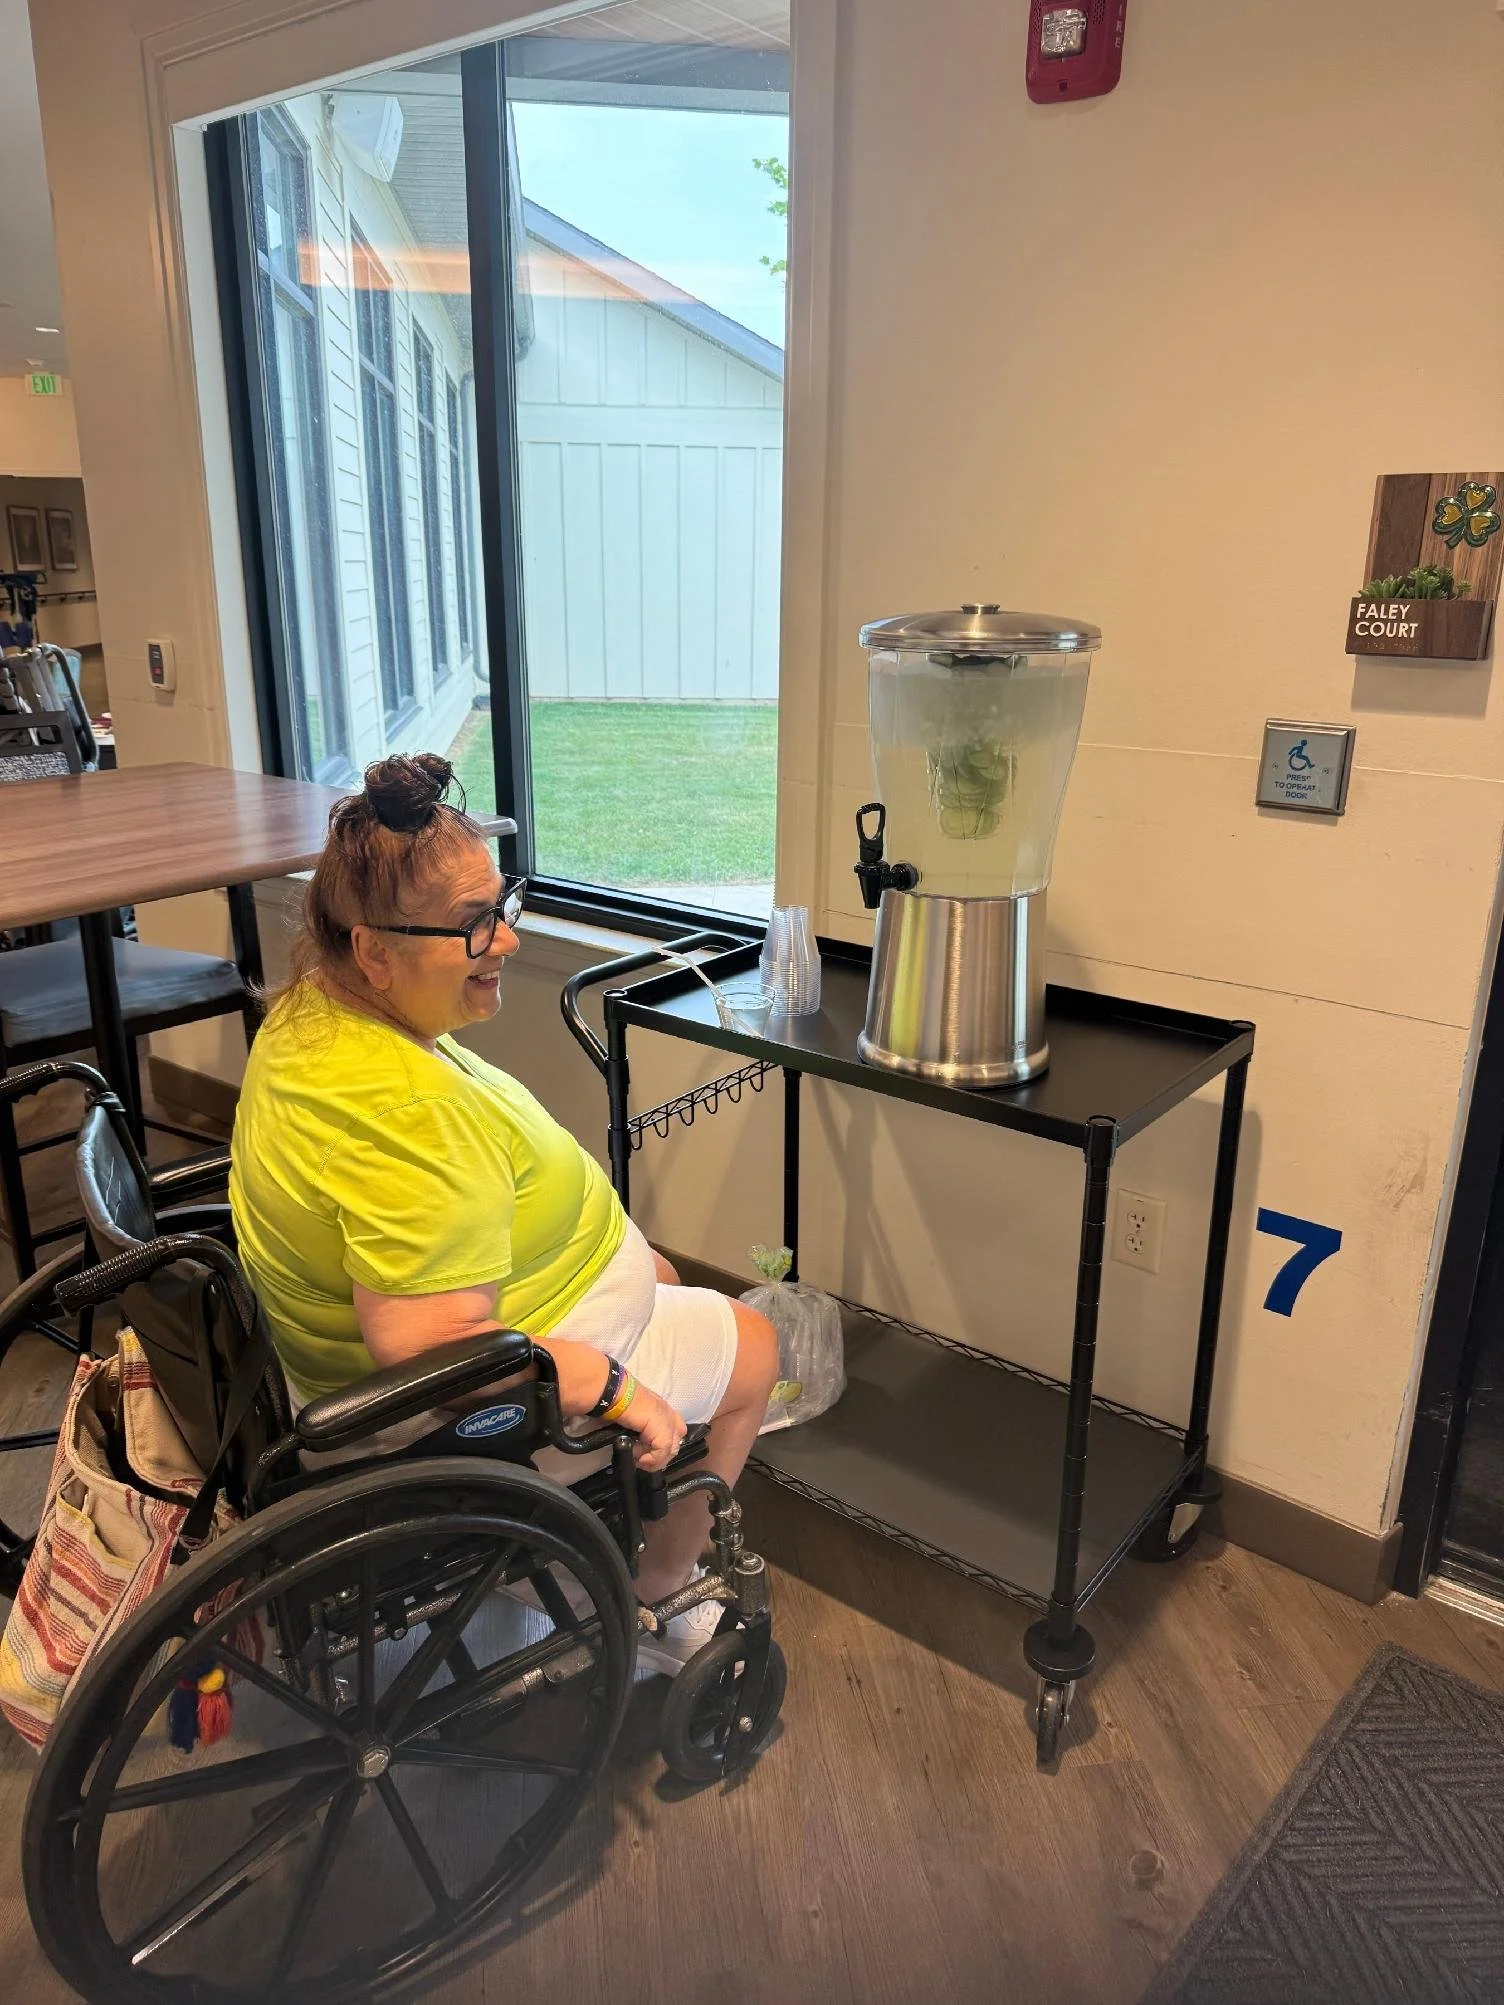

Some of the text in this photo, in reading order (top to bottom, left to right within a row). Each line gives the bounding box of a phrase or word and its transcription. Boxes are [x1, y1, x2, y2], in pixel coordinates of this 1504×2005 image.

[32, 375, 56, 394] EXIT
[1356, 603, 1411, 619] FALEY
[1355, 621, 1419, 638] COURT
[1274, 781, 1317, 791] TO OPERAT
[1256, 1207, 1342, 1317] 7
[464, 1408, 516, 1434] INVACARE
